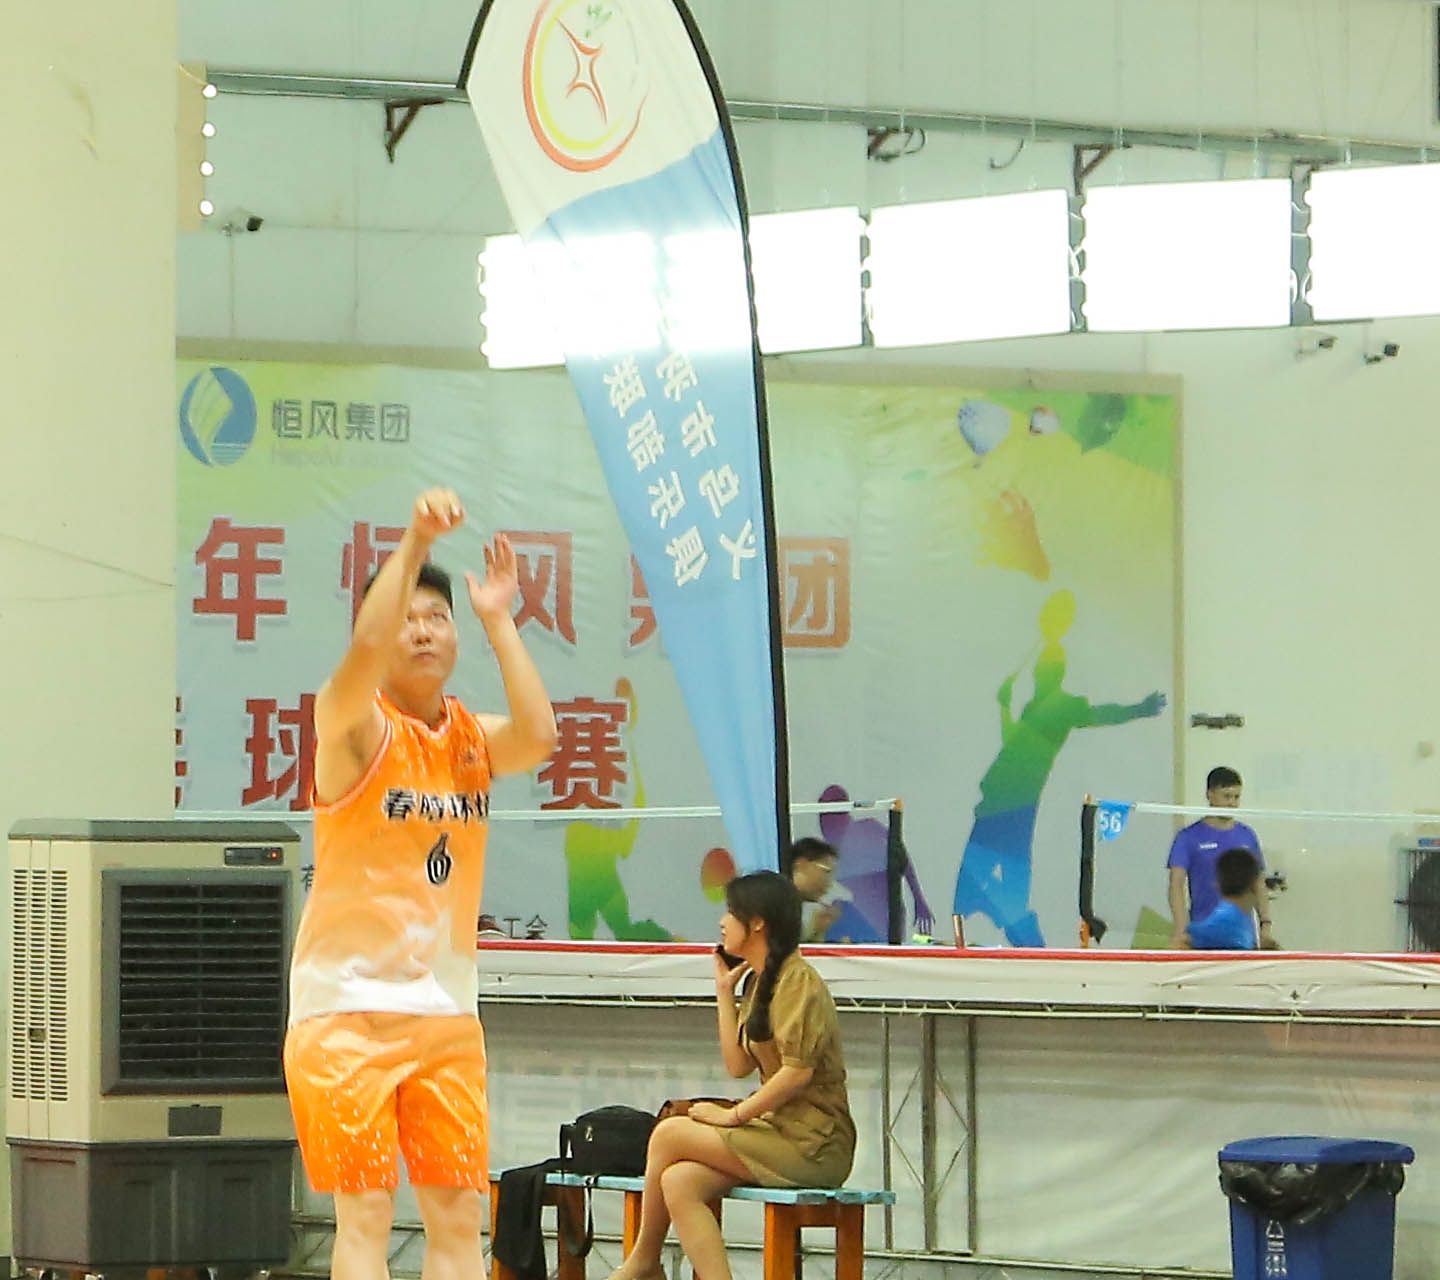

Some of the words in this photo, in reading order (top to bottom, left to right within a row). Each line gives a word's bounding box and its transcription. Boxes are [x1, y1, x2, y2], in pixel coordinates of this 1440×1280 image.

[272, 399, 411, 444] 恒风集团
[425, 832, 453, 885] 6
